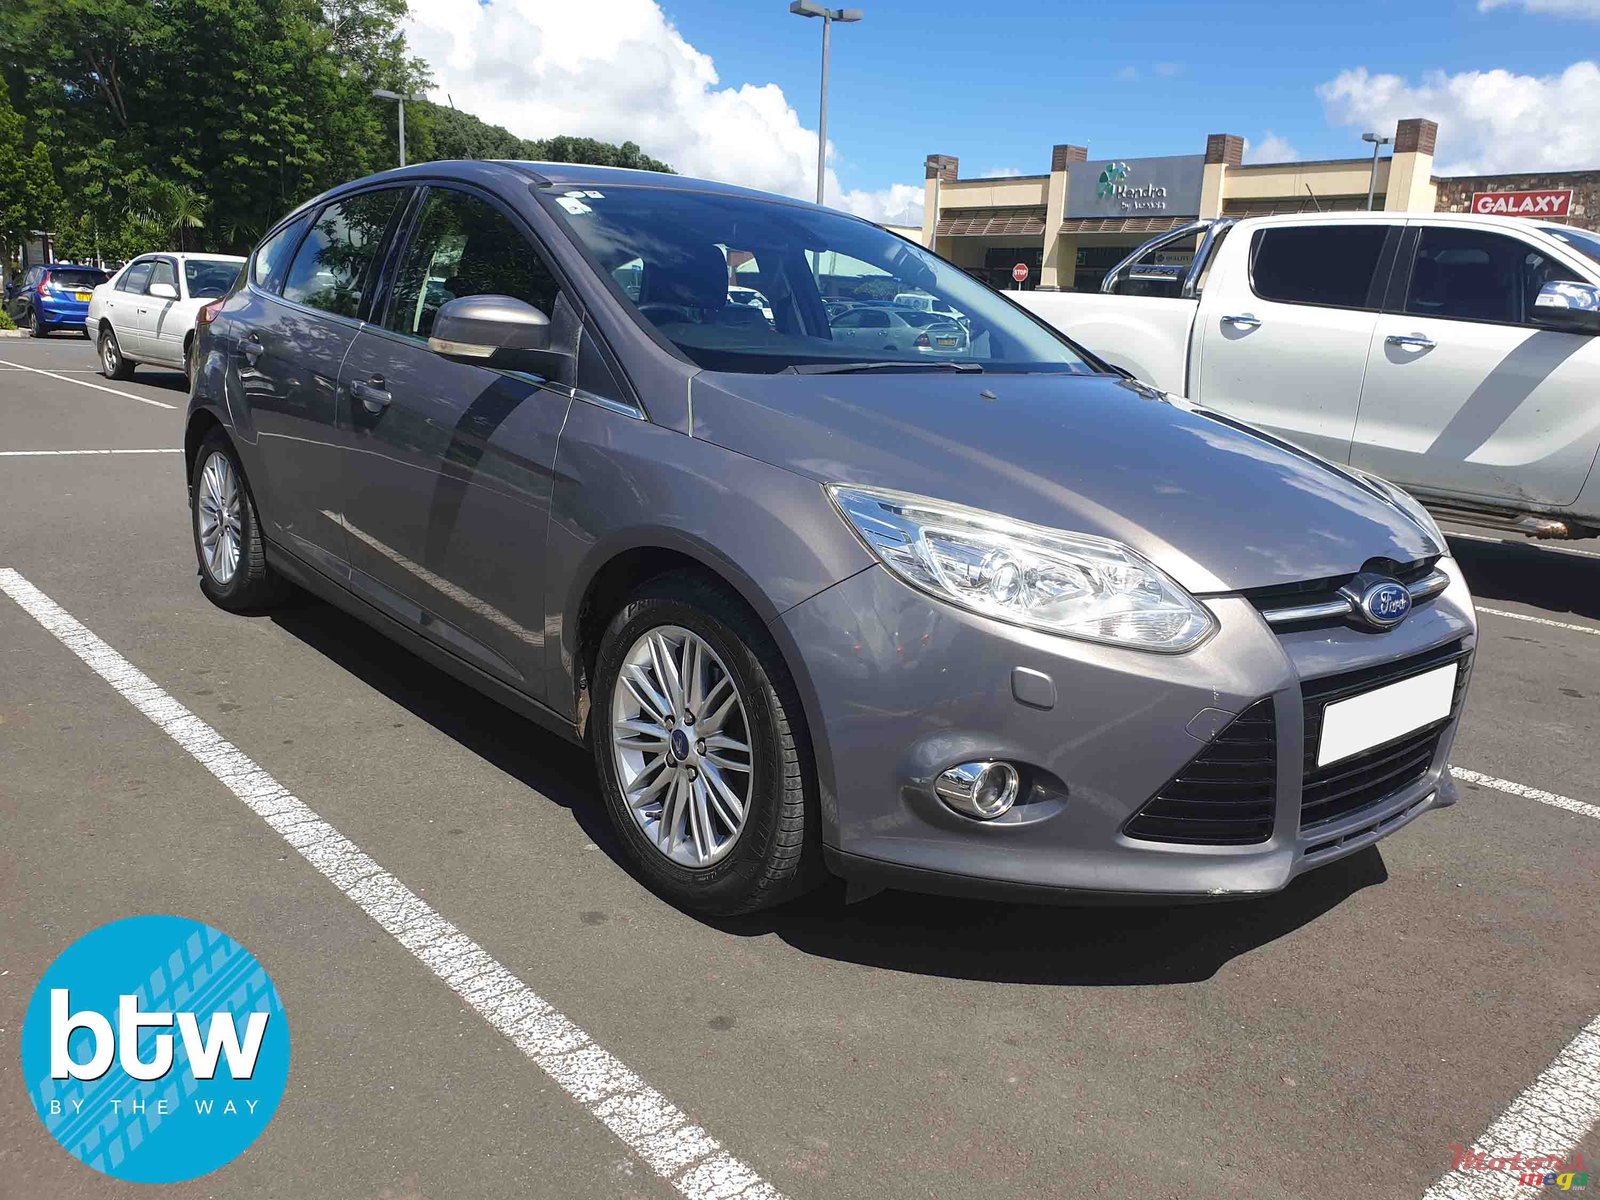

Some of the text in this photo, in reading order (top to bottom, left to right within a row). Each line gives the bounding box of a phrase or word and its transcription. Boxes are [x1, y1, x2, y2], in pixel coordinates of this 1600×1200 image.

[1116, 183, 1167, 199] Kendra
[1477, 195, 1565, 213] GALAXY
[1379, 590, 1407, 614] Ford
